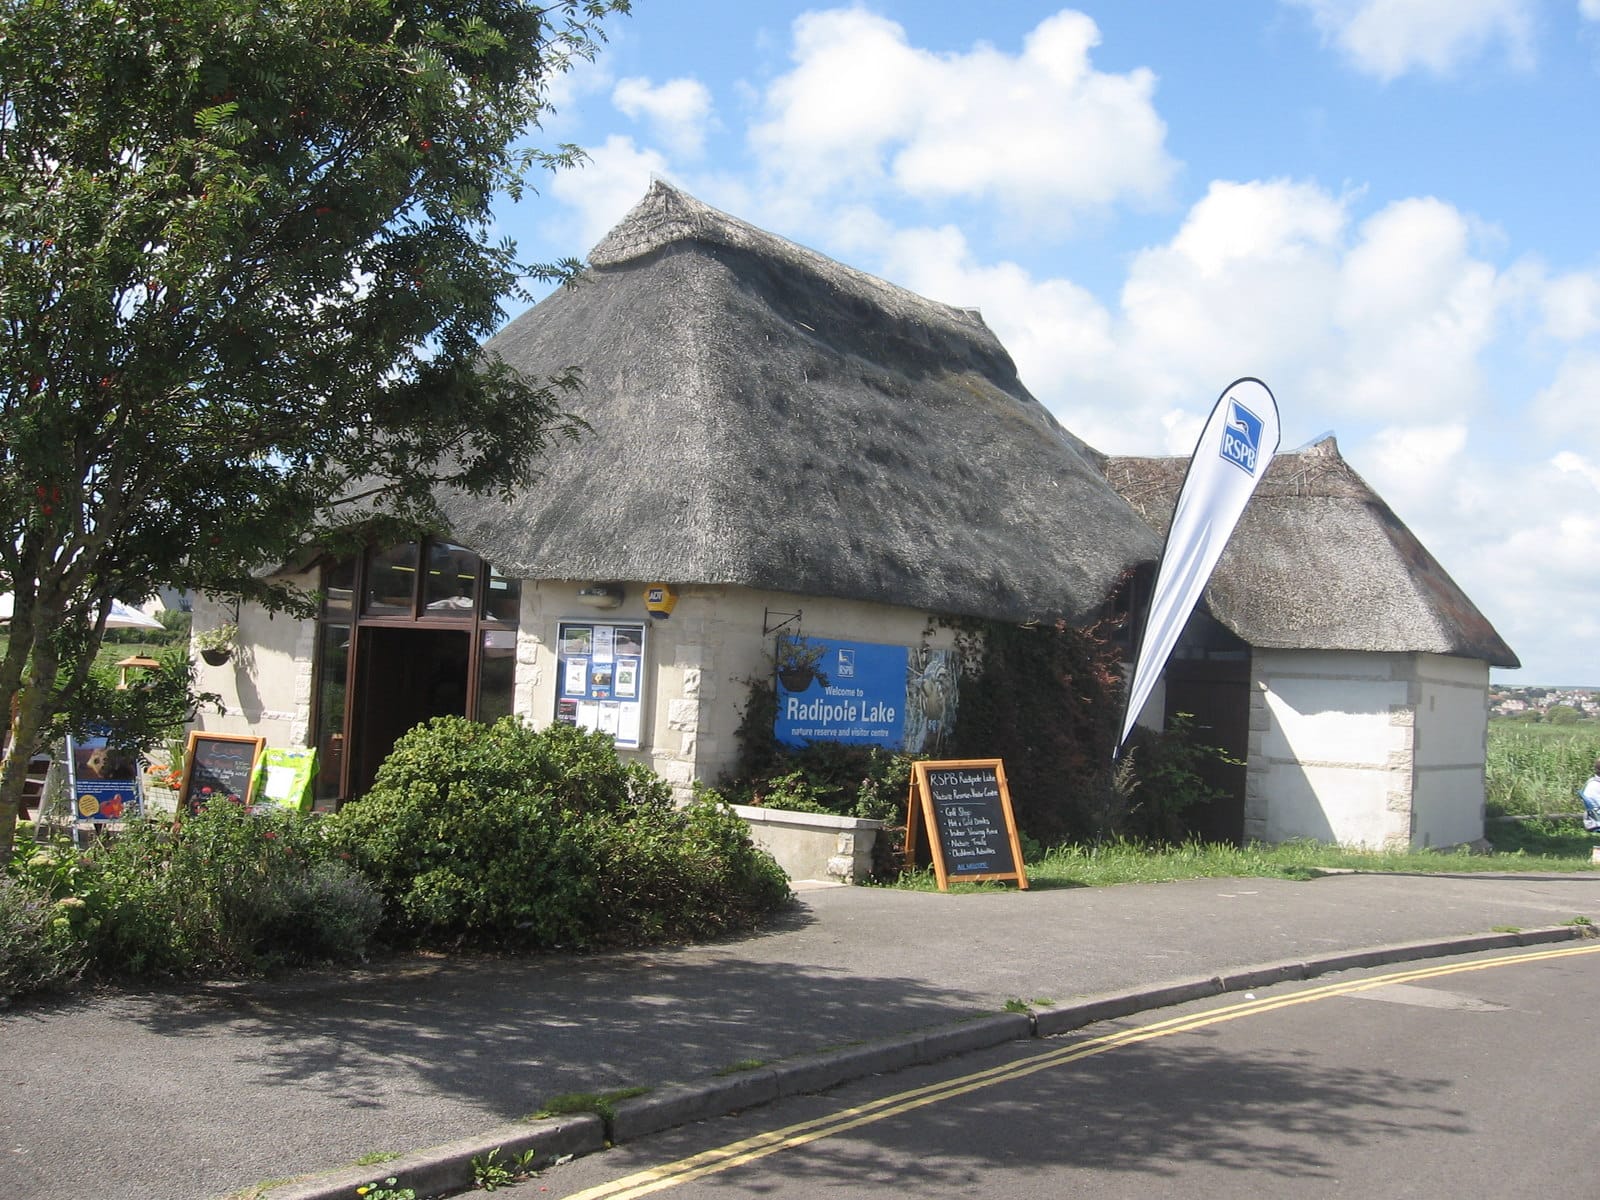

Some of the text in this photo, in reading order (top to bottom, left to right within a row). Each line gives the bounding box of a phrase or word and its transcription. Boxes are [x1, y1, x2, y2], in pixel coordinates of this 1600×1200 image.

[1224, 434, 1256, 468] RSPB
[649, 591, 663, 600] ADT
[839, 665, 853, 675] RSPB
[824, 686, 864, 697] Welcome to
[787, 697, 895, 726] Radipole Lake
[791, 727, 889, 737] nature reserve and visitor centre
[930, 772, 958, 786] RSPB
